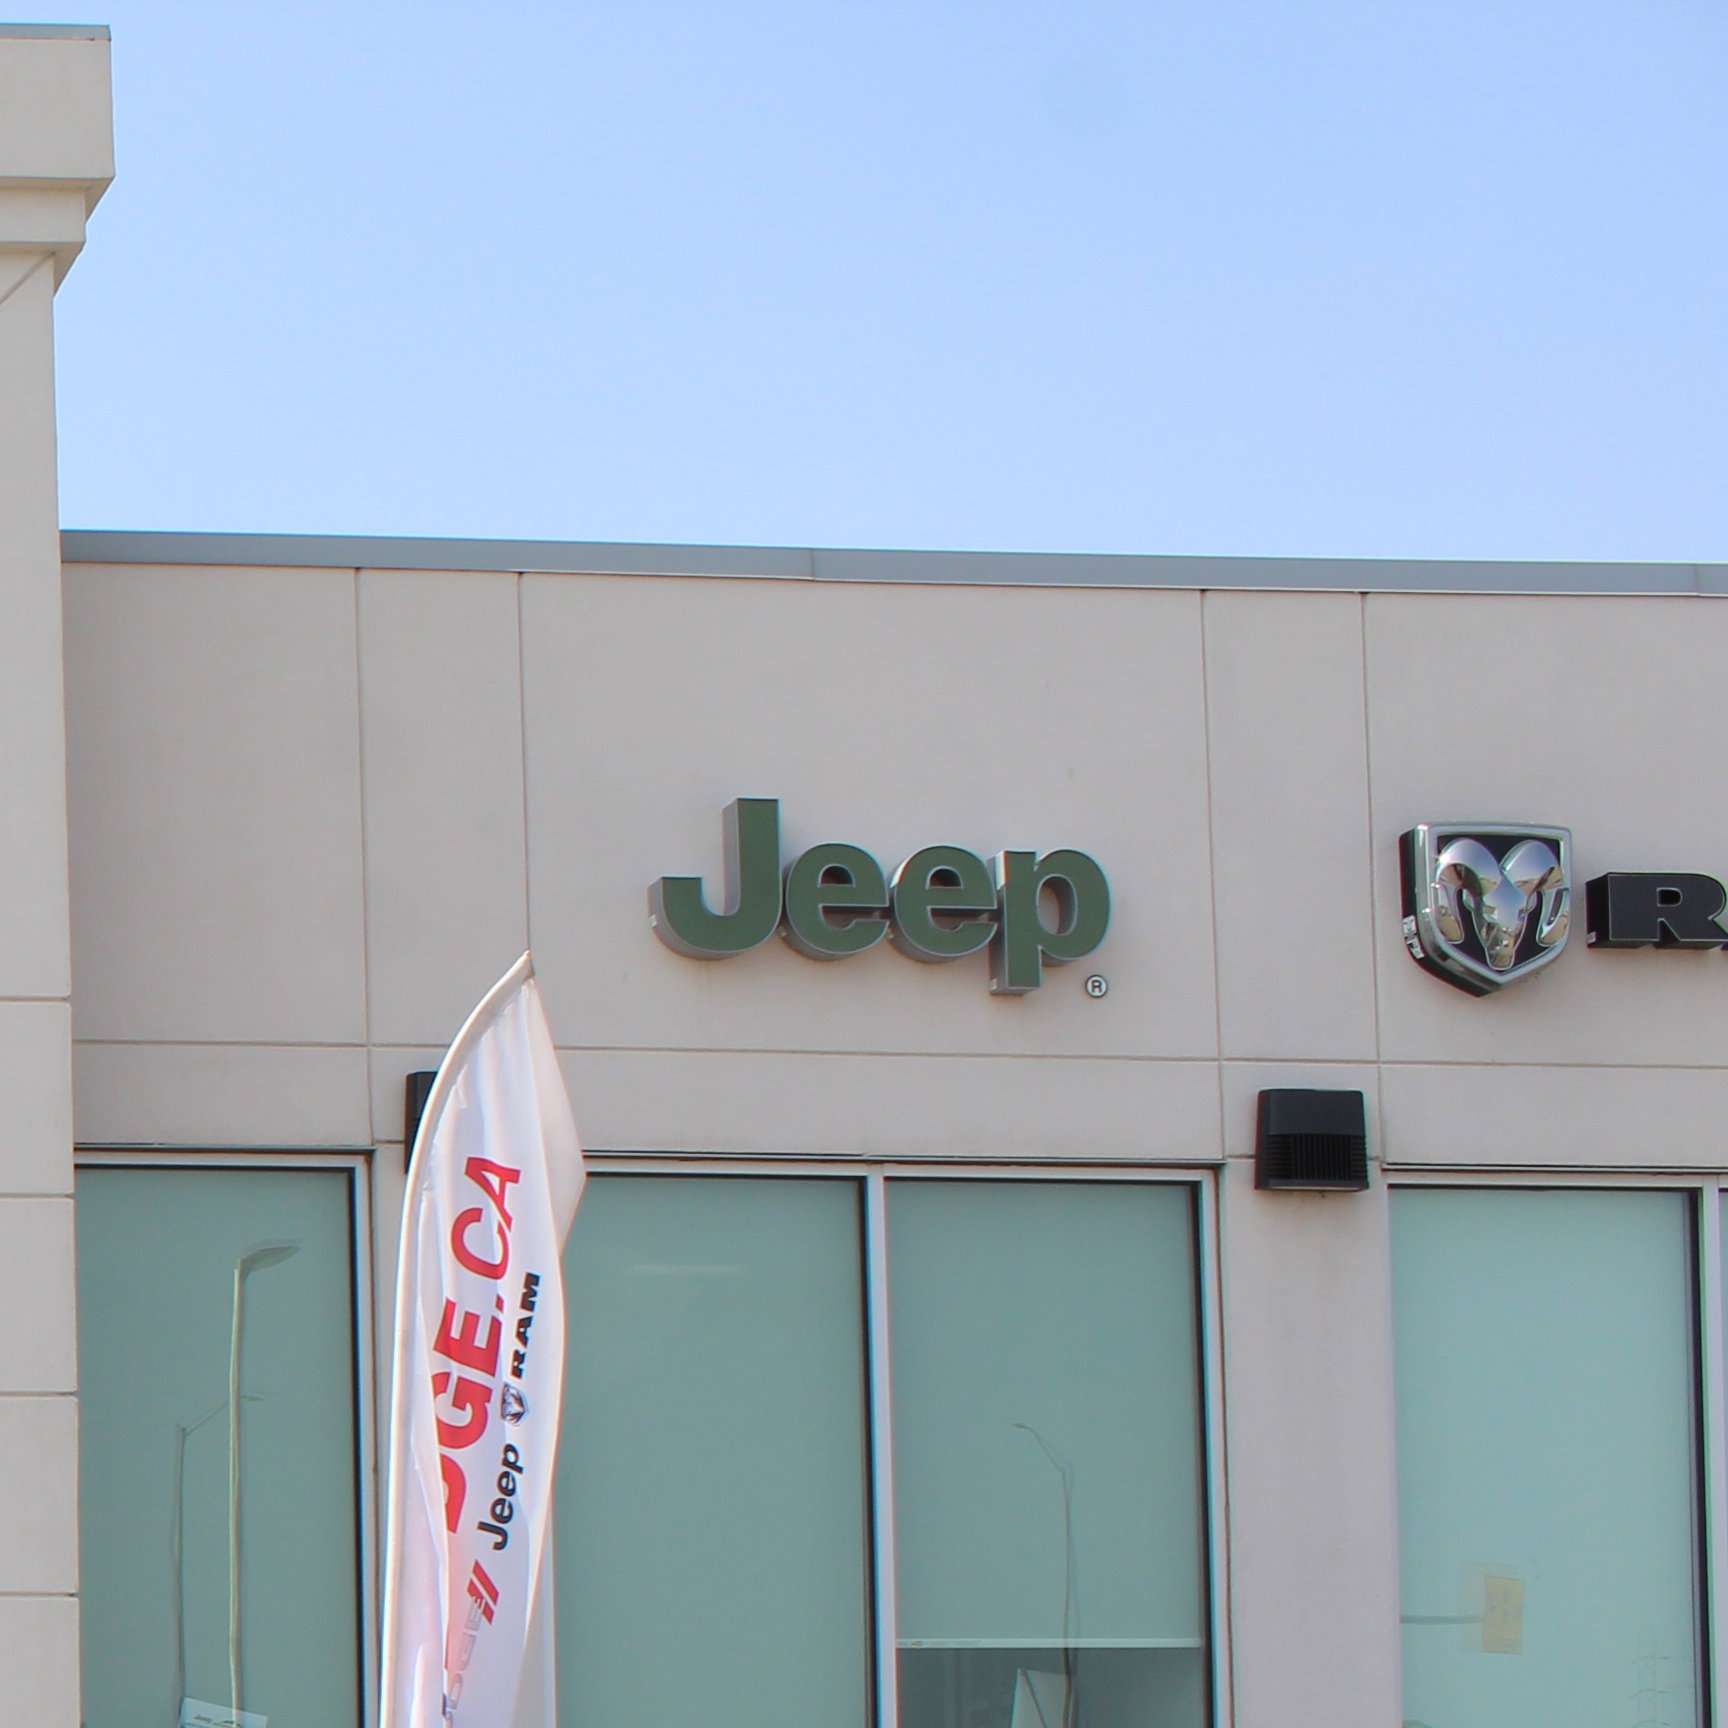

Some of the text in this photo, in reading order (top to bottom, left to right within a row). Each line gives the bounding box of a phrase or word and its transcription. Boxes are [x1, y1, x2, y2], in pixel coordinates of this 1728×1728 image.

[648, 797, 1112, 996] Jeep
[1586, 871, 1728, 951] R
[476, 1442, 525, 1552] Jeep
[510, 1271, 541, 1380] RAM
